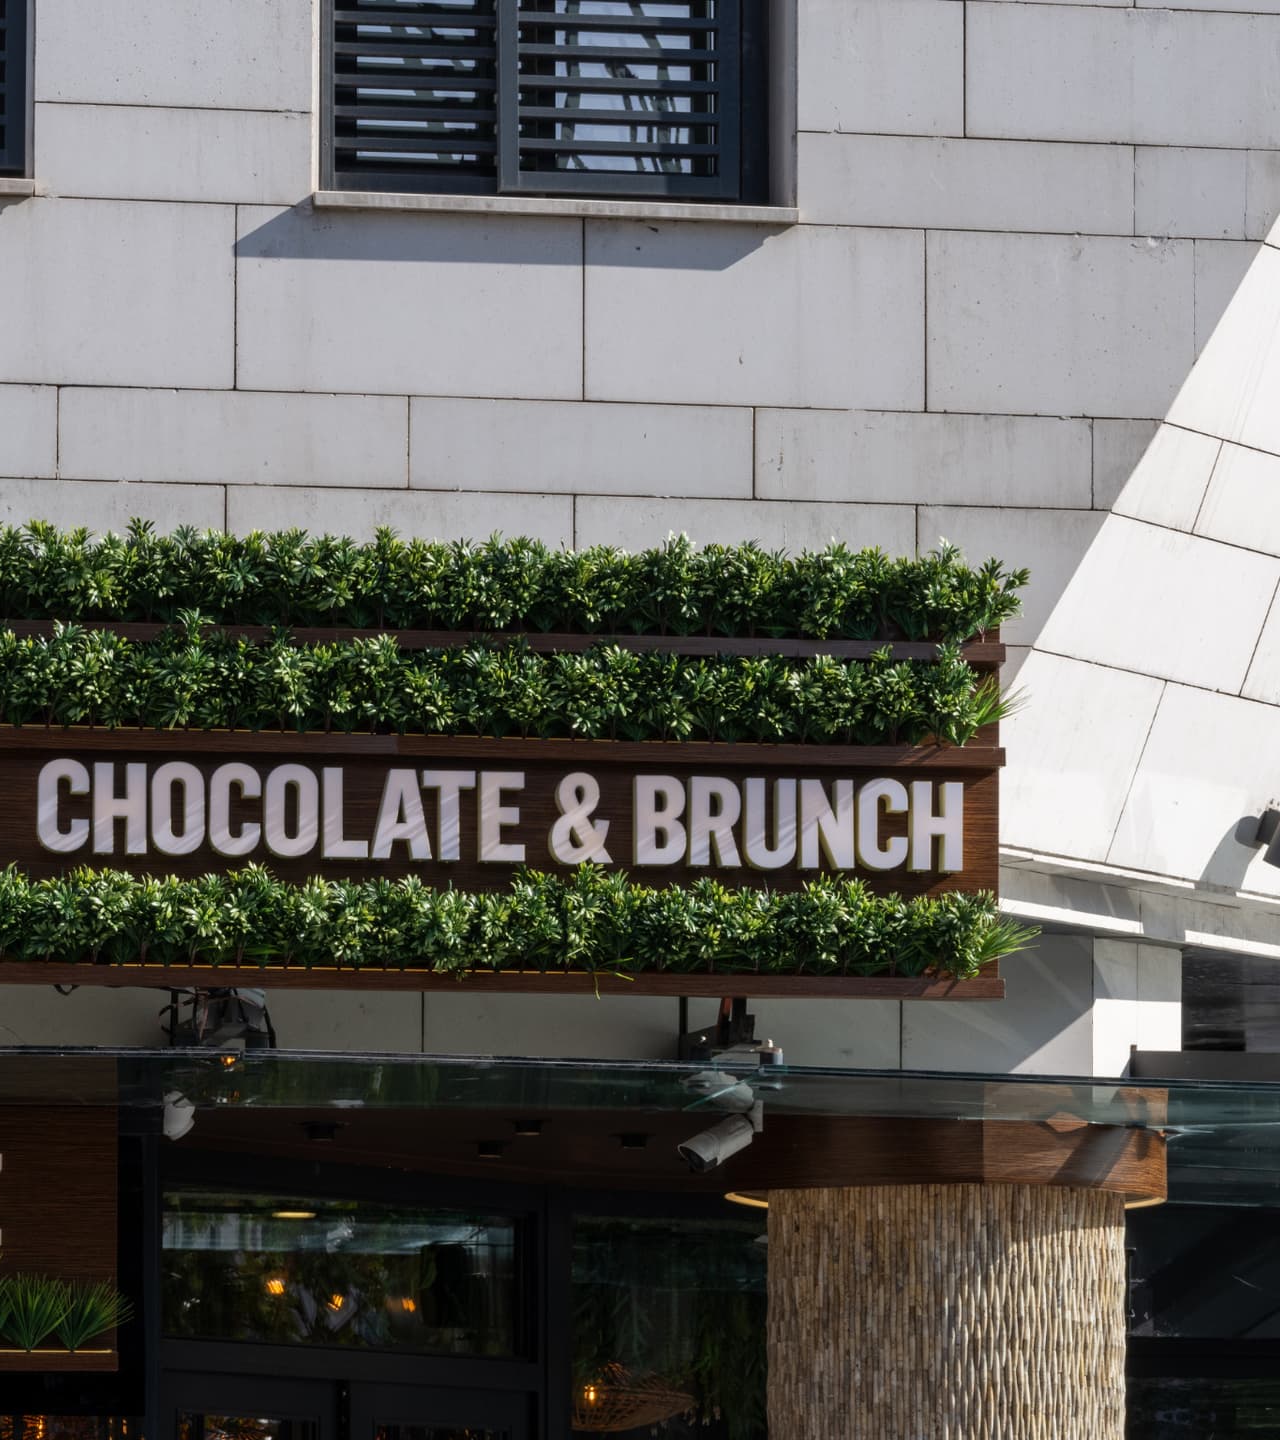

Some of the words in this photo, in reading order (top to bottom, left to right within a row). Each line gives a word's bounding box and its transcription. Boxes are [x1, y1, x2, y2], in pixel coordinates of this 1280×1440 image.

[36, 758, 527, 862] CHOCOLATE
[549, 772, 613, 865] &
[633, 774, 964, 874] BRUNCH
